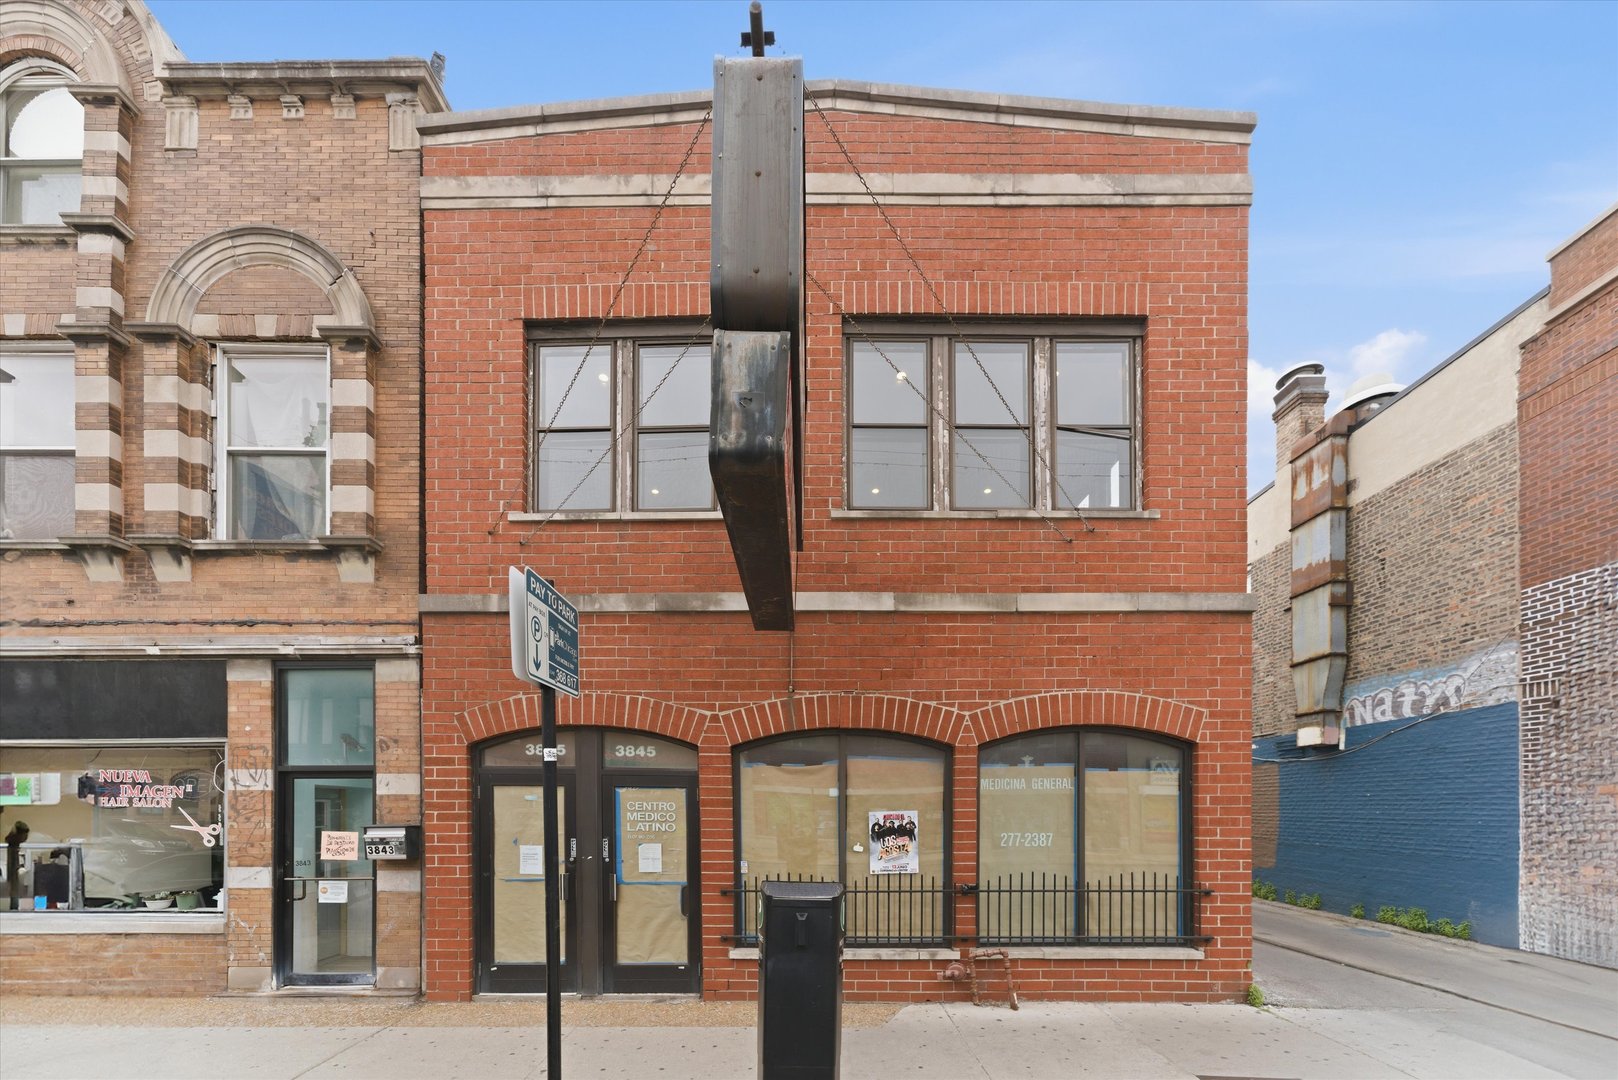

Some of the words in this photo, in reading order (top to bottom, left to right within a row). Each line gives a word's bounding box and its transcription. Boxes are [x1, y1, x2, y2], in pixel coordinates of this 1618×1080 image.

[530, 576, 545, 600] PAY
[547, 590, 557, 609] TO
[558, 600, 576, 625] PARK
[525, 744, 566, 756] 385
[615, 745, 657, 757] 3845
[99, 769, 152, 783] NUEVA
[980, 778, 1026, 790] MEDICINA
[1031, 777, 1073, 790] GENERAL
[120, 784, 185, 798] IMAGEN
[99, 797, 129, 807] HAIR
[133, 797, 173, 808] SALON
[626, 801, 676, 811] CENTRO
[626, 812, 676, 821] MEDICO
[626, 822, 676, 832] LATINO
[1000, 832, 1053, 847] 277-2387
[367, 845, 395, 855] 3843
